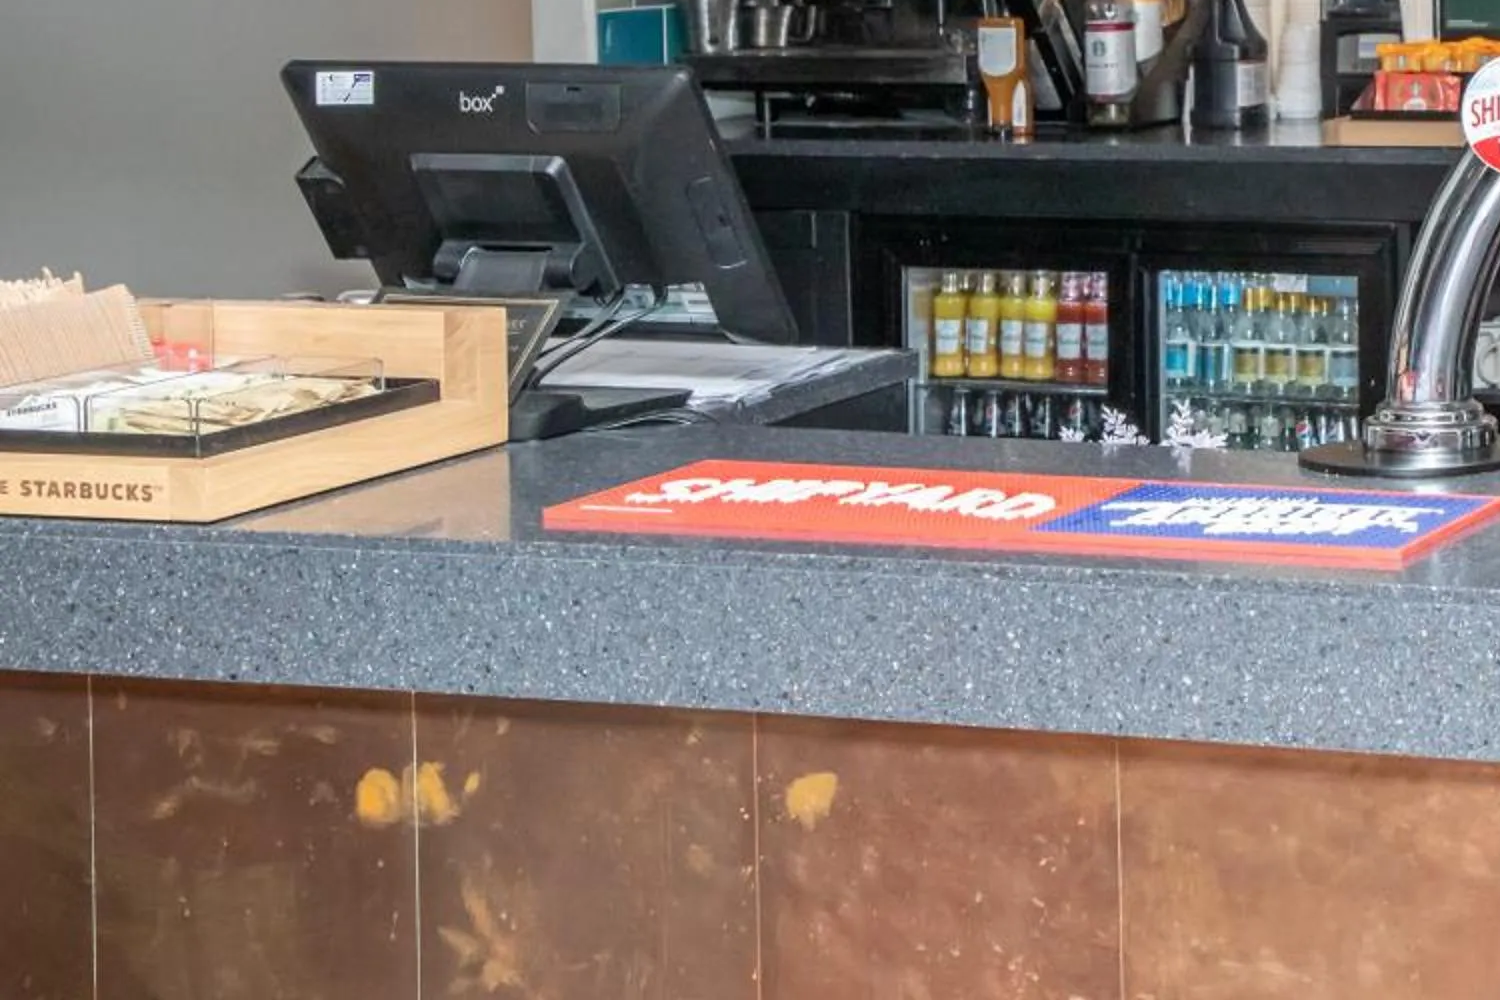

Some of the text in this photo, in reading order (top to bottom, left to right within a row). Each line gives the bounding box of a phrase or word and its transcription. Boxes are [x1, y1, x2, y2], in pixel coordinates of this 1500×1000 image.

[459, 91, 494, 113] box
[19, 479, 153, 503] STARBUCKS
[625, 478, 1056, 521] SHIPYARD
